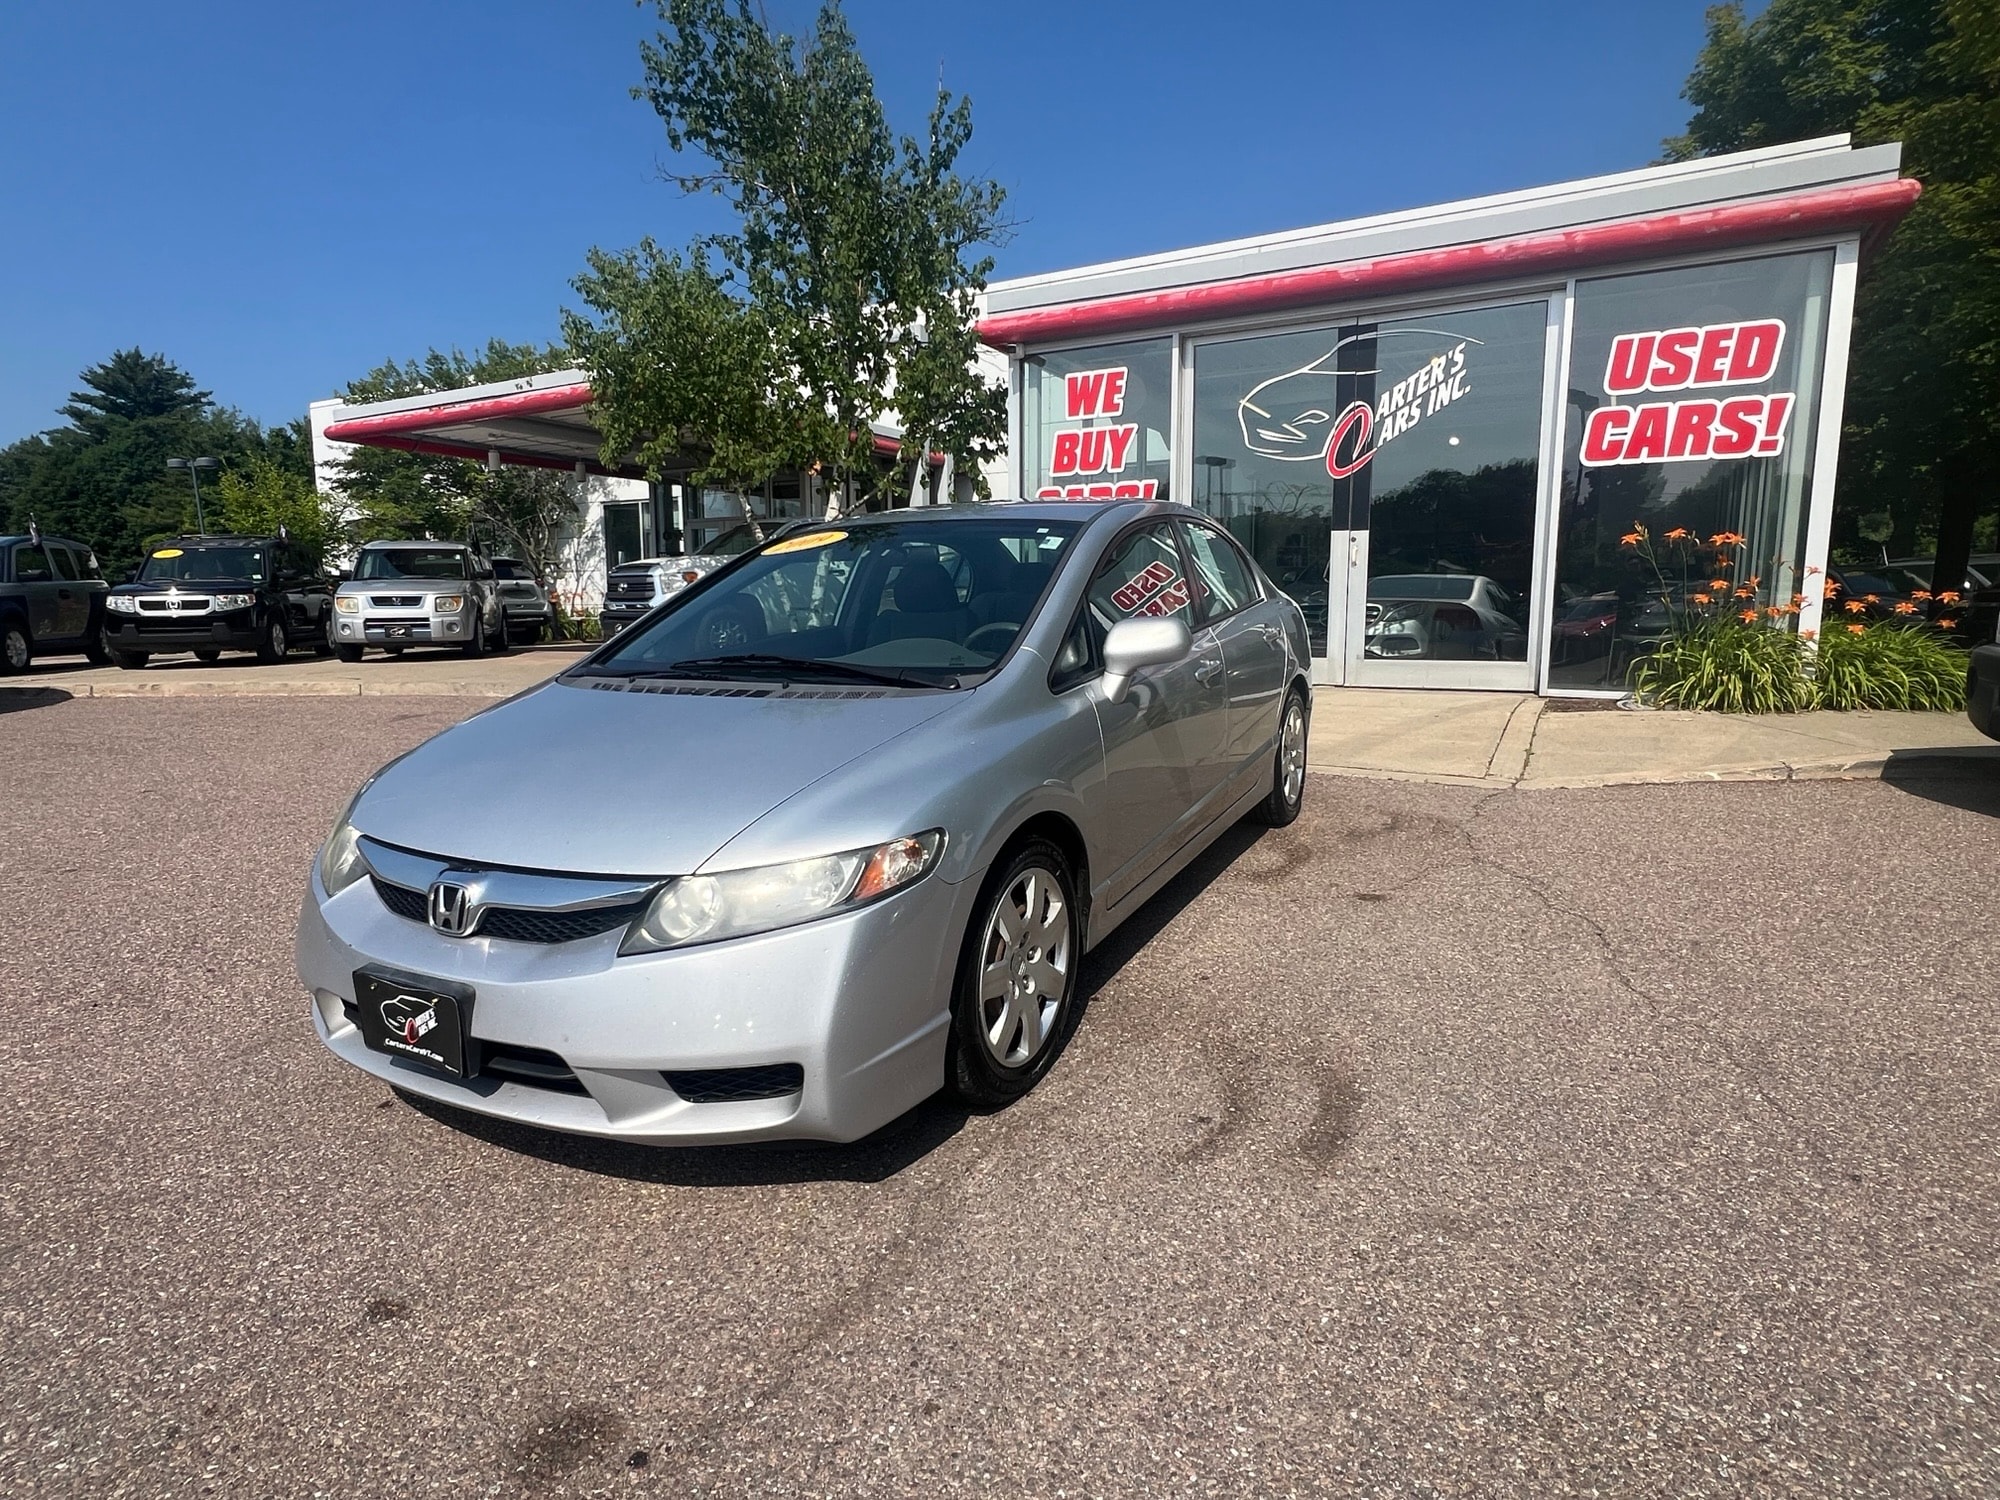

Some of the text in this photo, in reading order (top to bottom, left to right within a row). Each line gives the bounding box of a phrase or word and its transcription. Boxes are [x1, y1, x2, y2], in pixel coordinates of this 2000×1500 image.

[1604, 319, 1785, 395] USED
[1065, 367, 1128, 420] WE
[1427, 369, 1472, 417] INC.
[1050, 423, 1138, 477] BUY
[1580, 393, 1796, 466] CARS!
